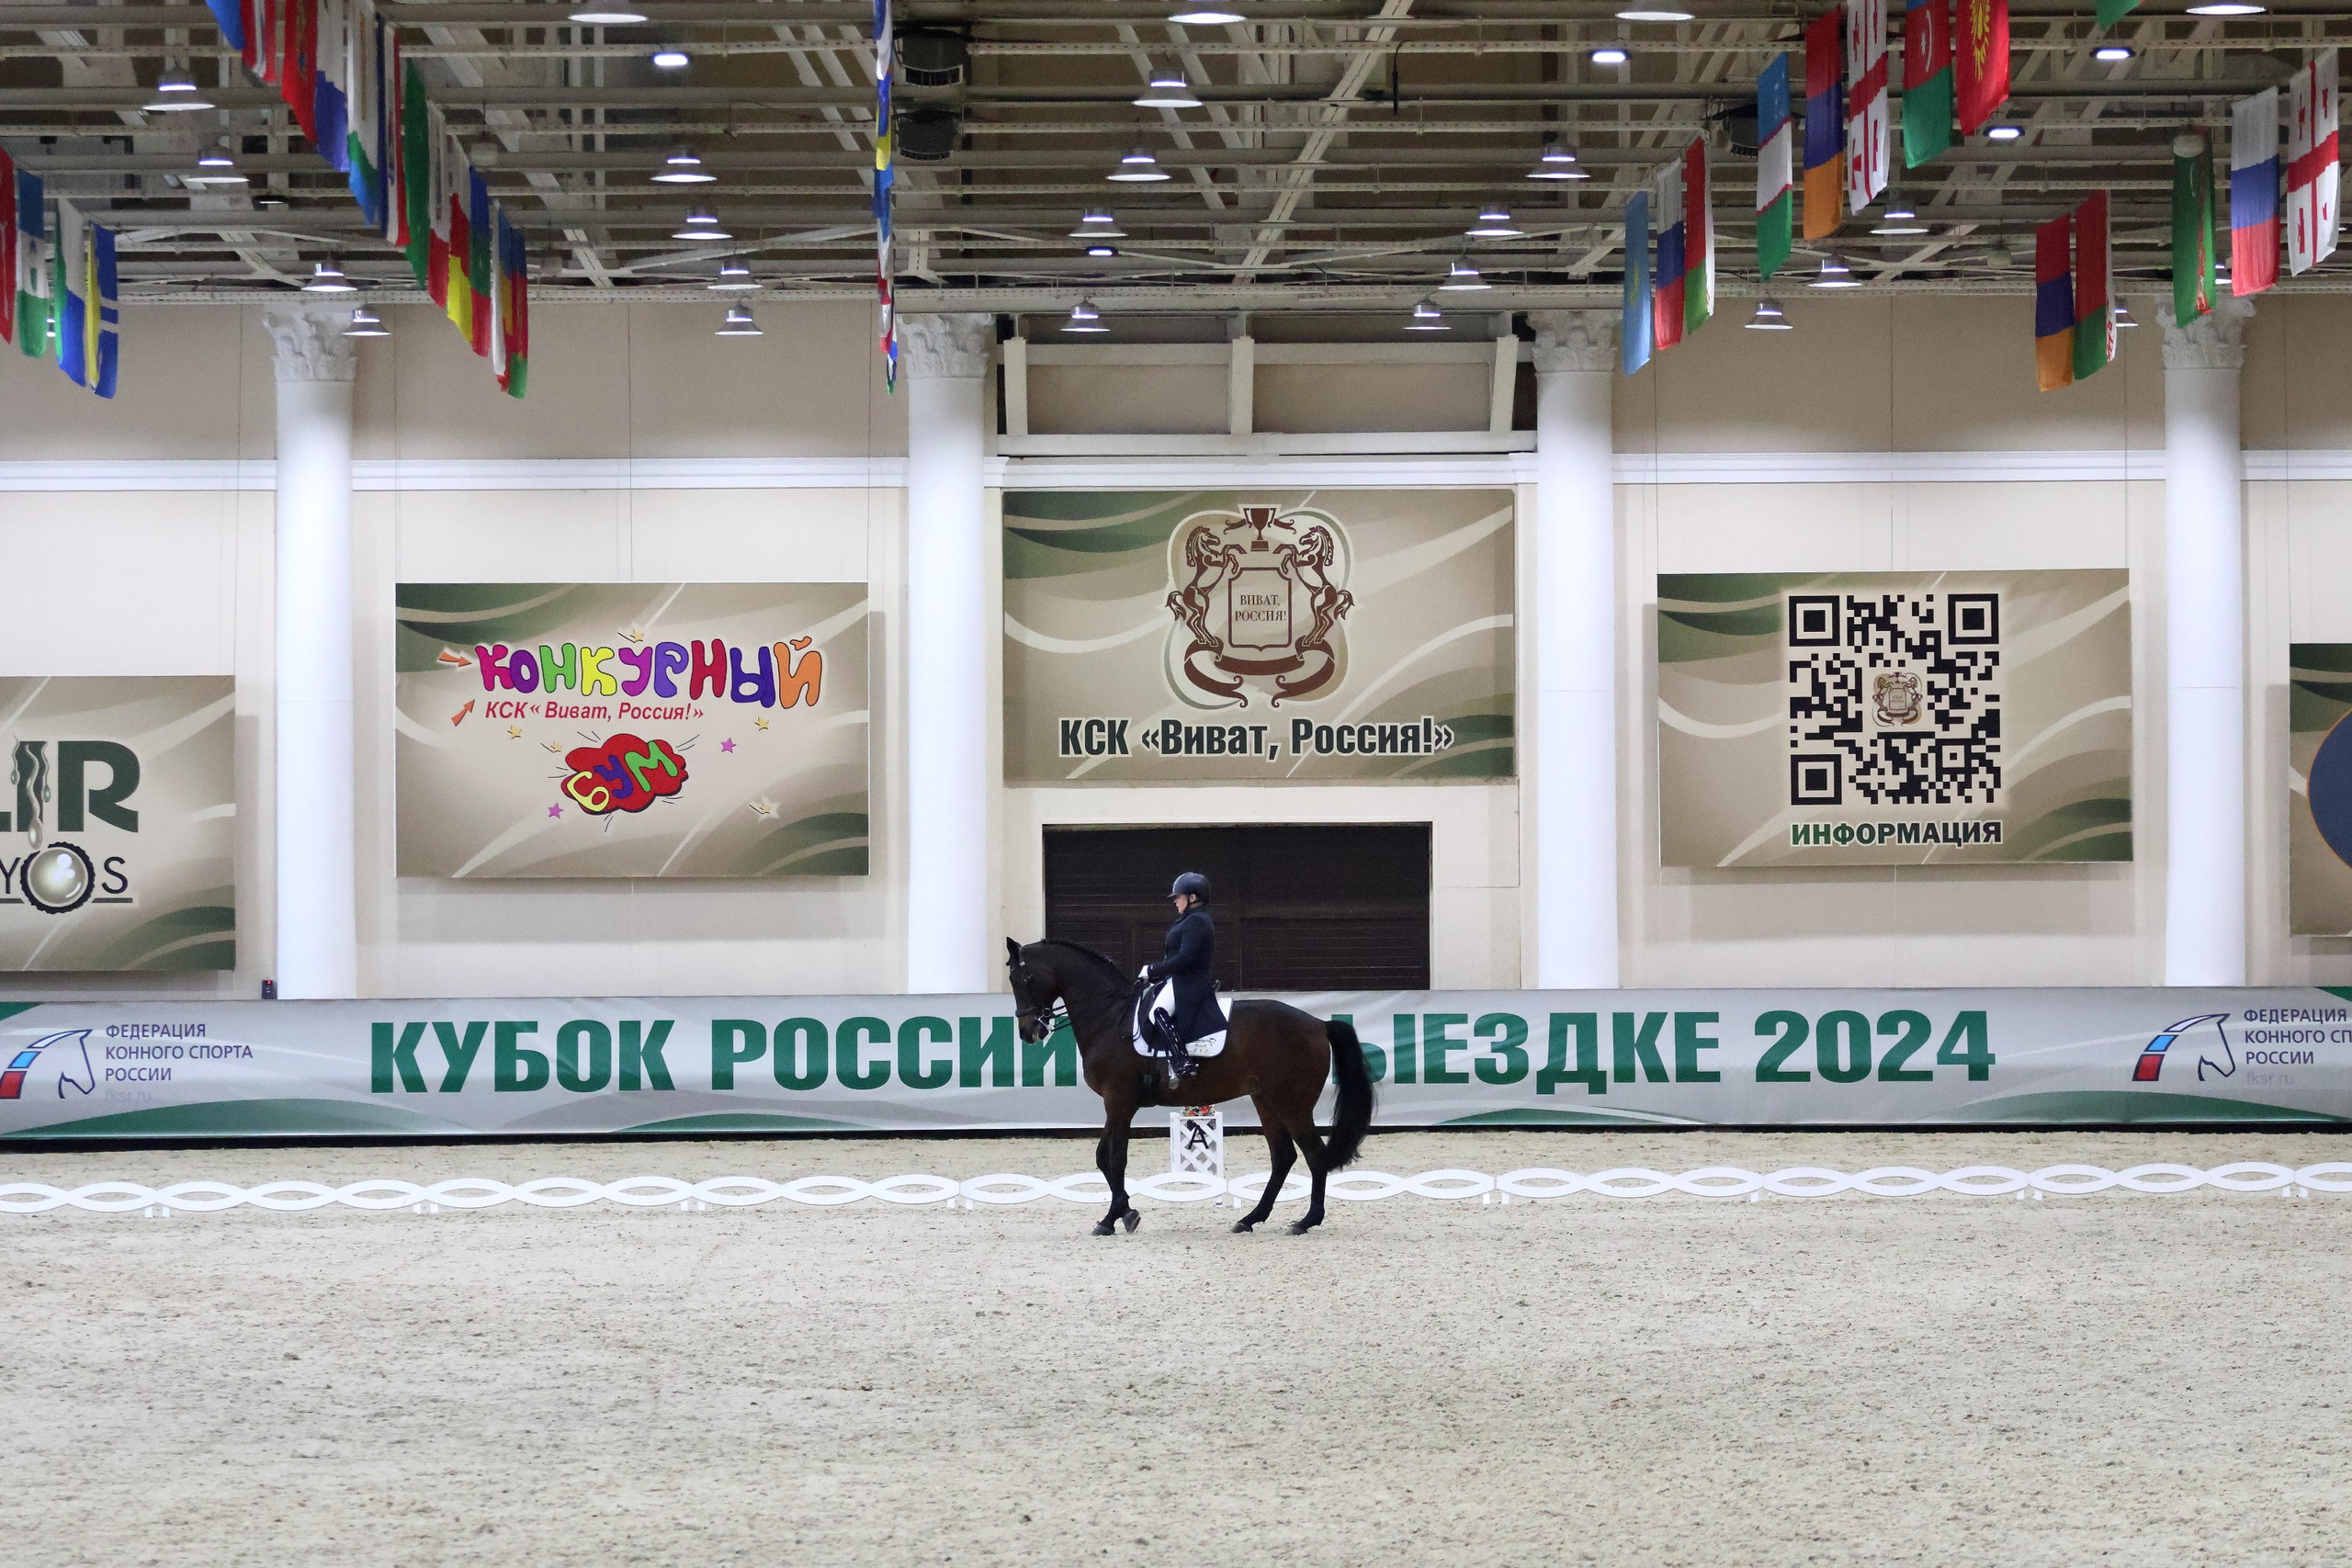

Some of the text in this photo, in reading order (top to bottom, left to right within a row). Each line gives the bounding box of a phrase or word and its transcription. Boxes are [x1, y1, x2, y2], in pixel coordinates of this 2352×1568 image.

[1239, 594, 1280, 606] ВИВАТ,
[1235, 610, 1287, 622] РОССИЯ!
[475, 637, 822, 709] КОНКУРНЫЙ
[618, 702, 705, 720] Россия!»
[1060, 717, 1454, 761] КСК «Виват, Россия!»
[0, 740, 141, 833] IR
[1792, 821, 2002, 848] ИНФОРМАЦИЯ
[2244, 1009, 2347, 1024] ФЕДЕРАЦИЯ
[106, 1023, 206, 1040] ФЕДЕРАЦИЯ
[2245, 1030, 2325, 1043] КОННОГО
[106, 1044, 254, 1060] КОННОГО СПОРТА
[370, 1010, 1996, 1095] КУБОК РОССИИ ЫЕЗДКЕ 2024
[2245, 1051, 2314, 1065] РОССИИ
[106, 1067, 172, 1081] РОССИИ
[1187, 1124, 1209, 1149] A
